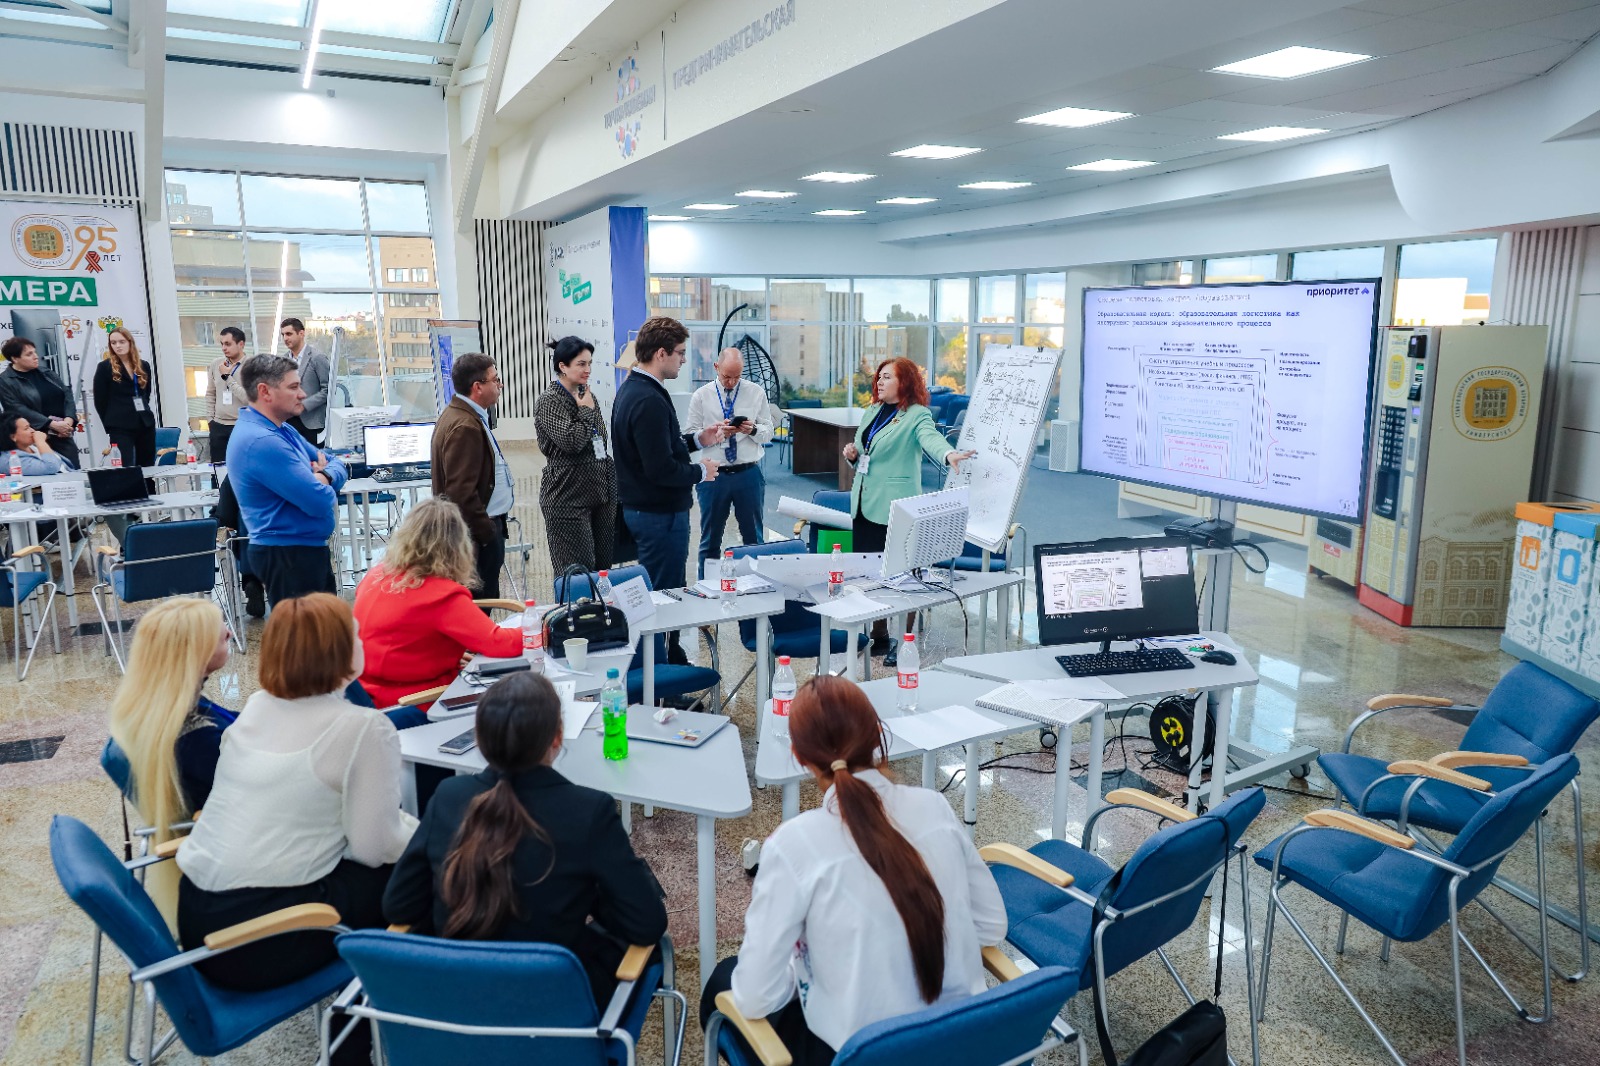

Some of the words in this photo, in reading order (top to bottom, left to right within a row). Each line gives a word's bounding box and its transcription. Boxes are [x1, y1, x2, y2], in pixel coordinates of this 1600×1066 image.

[70, 225, 118, 270] 95
[102, 254, 121, 262] ЛЕТ
[1306, 287, 1360, 298] приоритет
